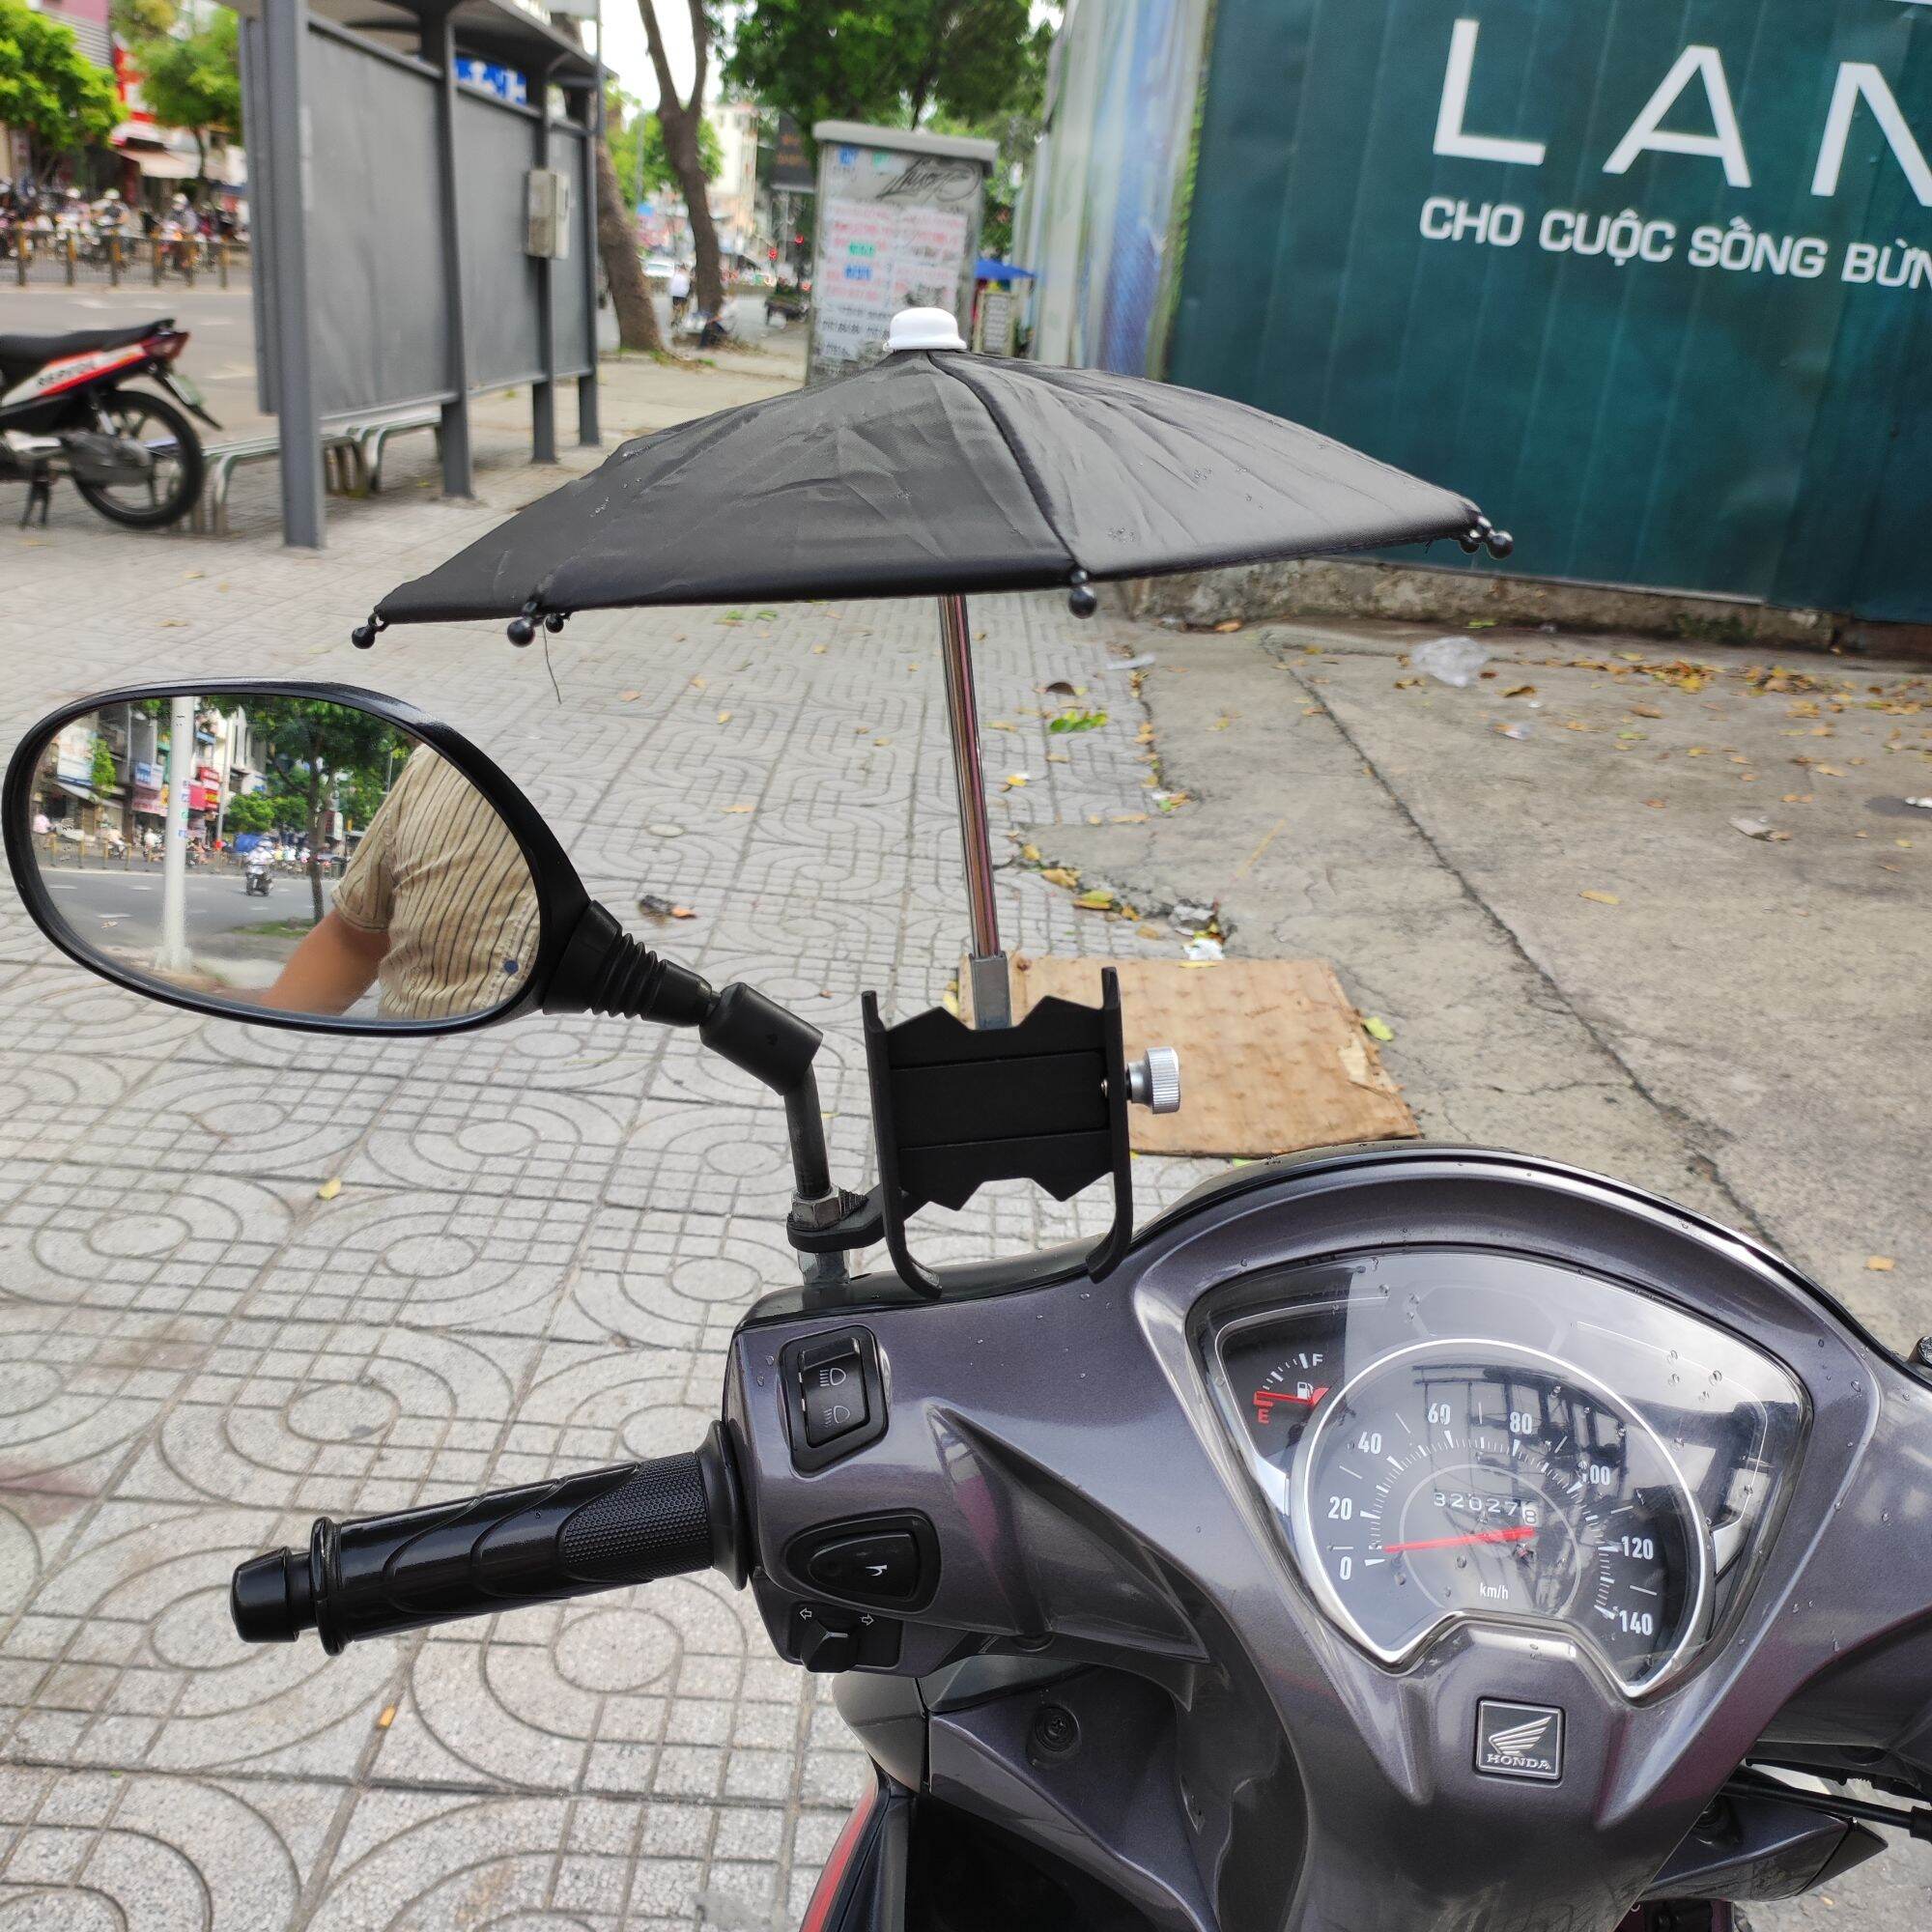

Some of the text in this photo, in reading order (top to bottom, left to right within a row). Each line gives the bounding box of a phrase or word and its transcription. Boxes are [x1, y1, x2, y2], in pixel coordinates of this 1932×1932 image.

[1433, 18, 1932, 207] LAN
[1419, 195, 1525, 247] CHO
[1539, 208, 1677, 267] CUỘC
[1688, 215, 1829, 279] SỐNG
[1312, 1352, 1324, 1367] F
[1258, 1407, 1270, 1425] E
[1427, 1403, 1451, 1425] 60
[1509, 1411, 1533, 1435] 80
[1358, 1432, 1382, 1455] 40
[1327, 1496, 1352, 1520] 20
[1621, 1535, 1654, 1560] 120
[1339, 1555, 1352, 1580] 0
[1479, 1582, 1509, 1600] km/h
[1619, 1609, 1654, 1636] 140
[1487, 1753, 1552, 1770] HONDA
